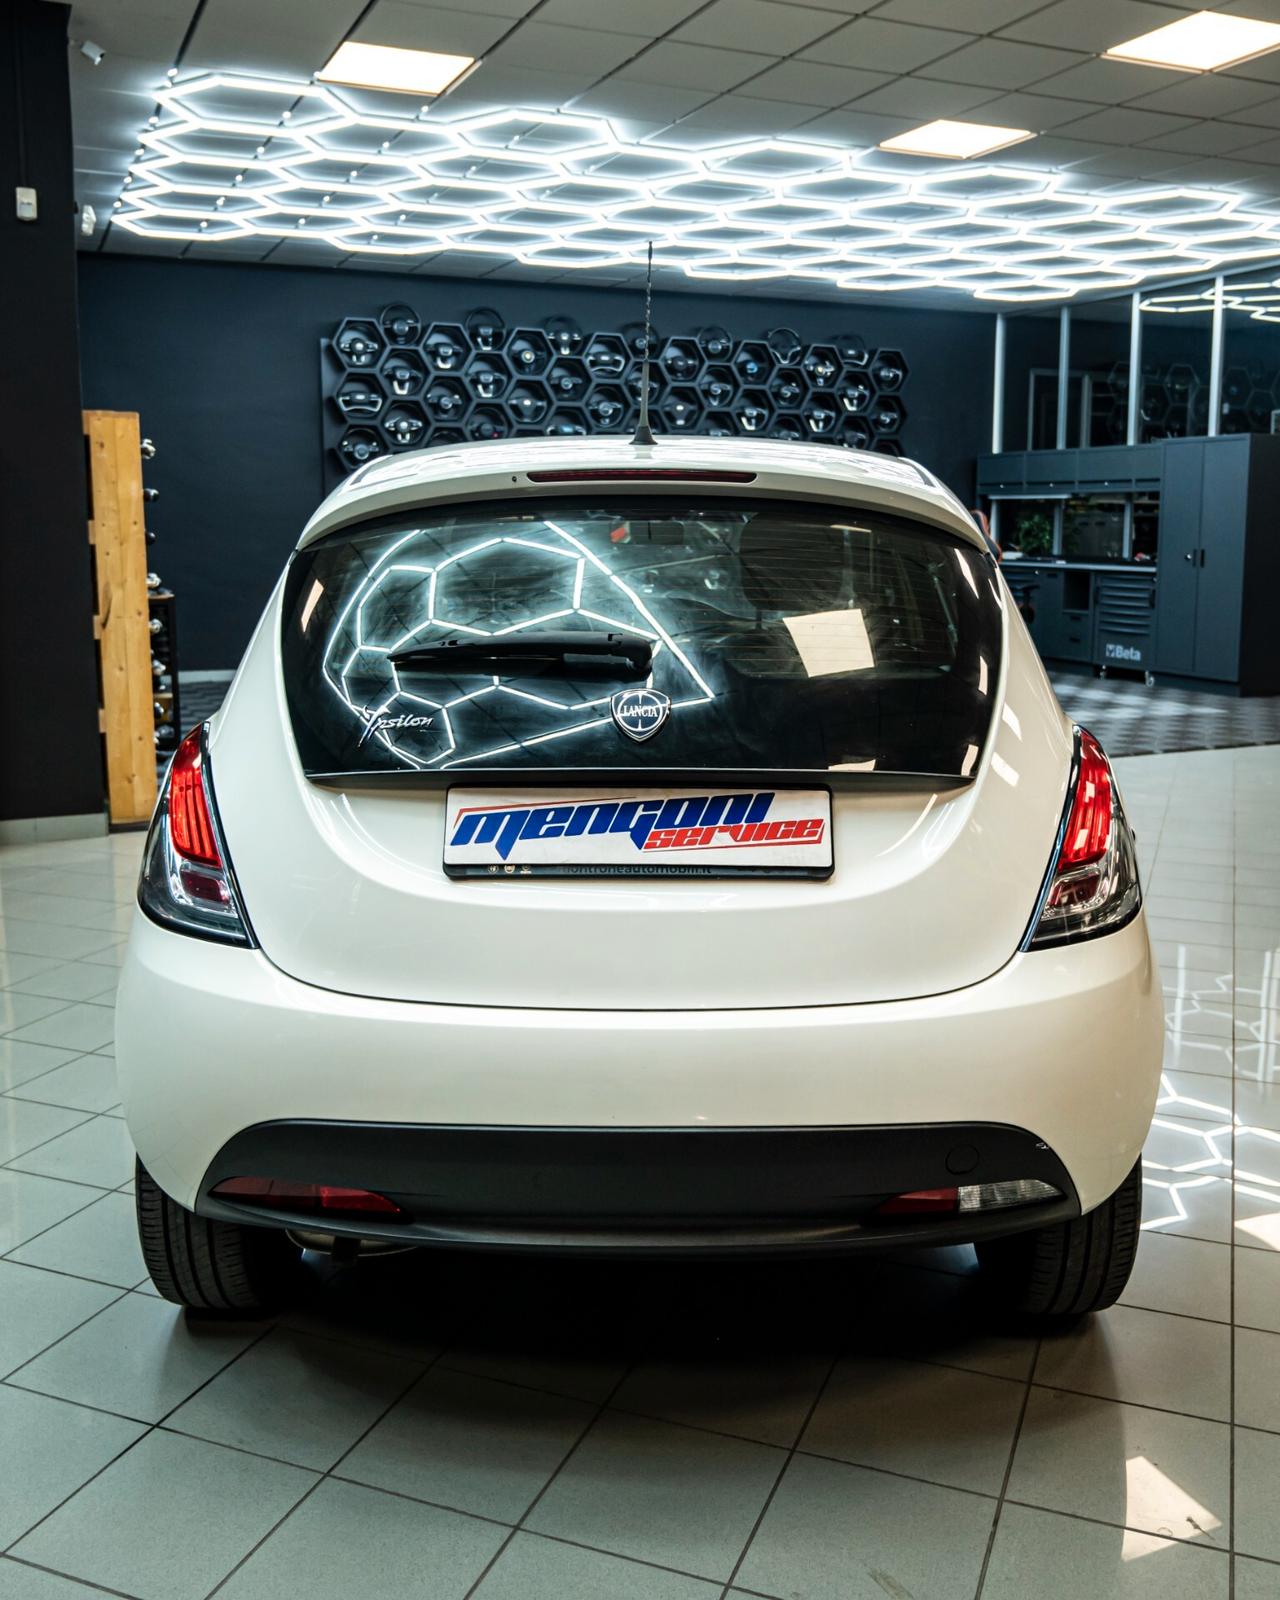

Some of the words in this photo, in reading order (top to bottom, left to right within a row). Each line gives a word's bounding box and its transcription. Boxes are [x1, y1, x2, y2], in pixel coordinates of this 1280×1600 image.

[1115, 644, 1142, 661] Beta
[623, 705, 658, 718] LANCIA
[357, 705, 434, 747] Ypsilon
